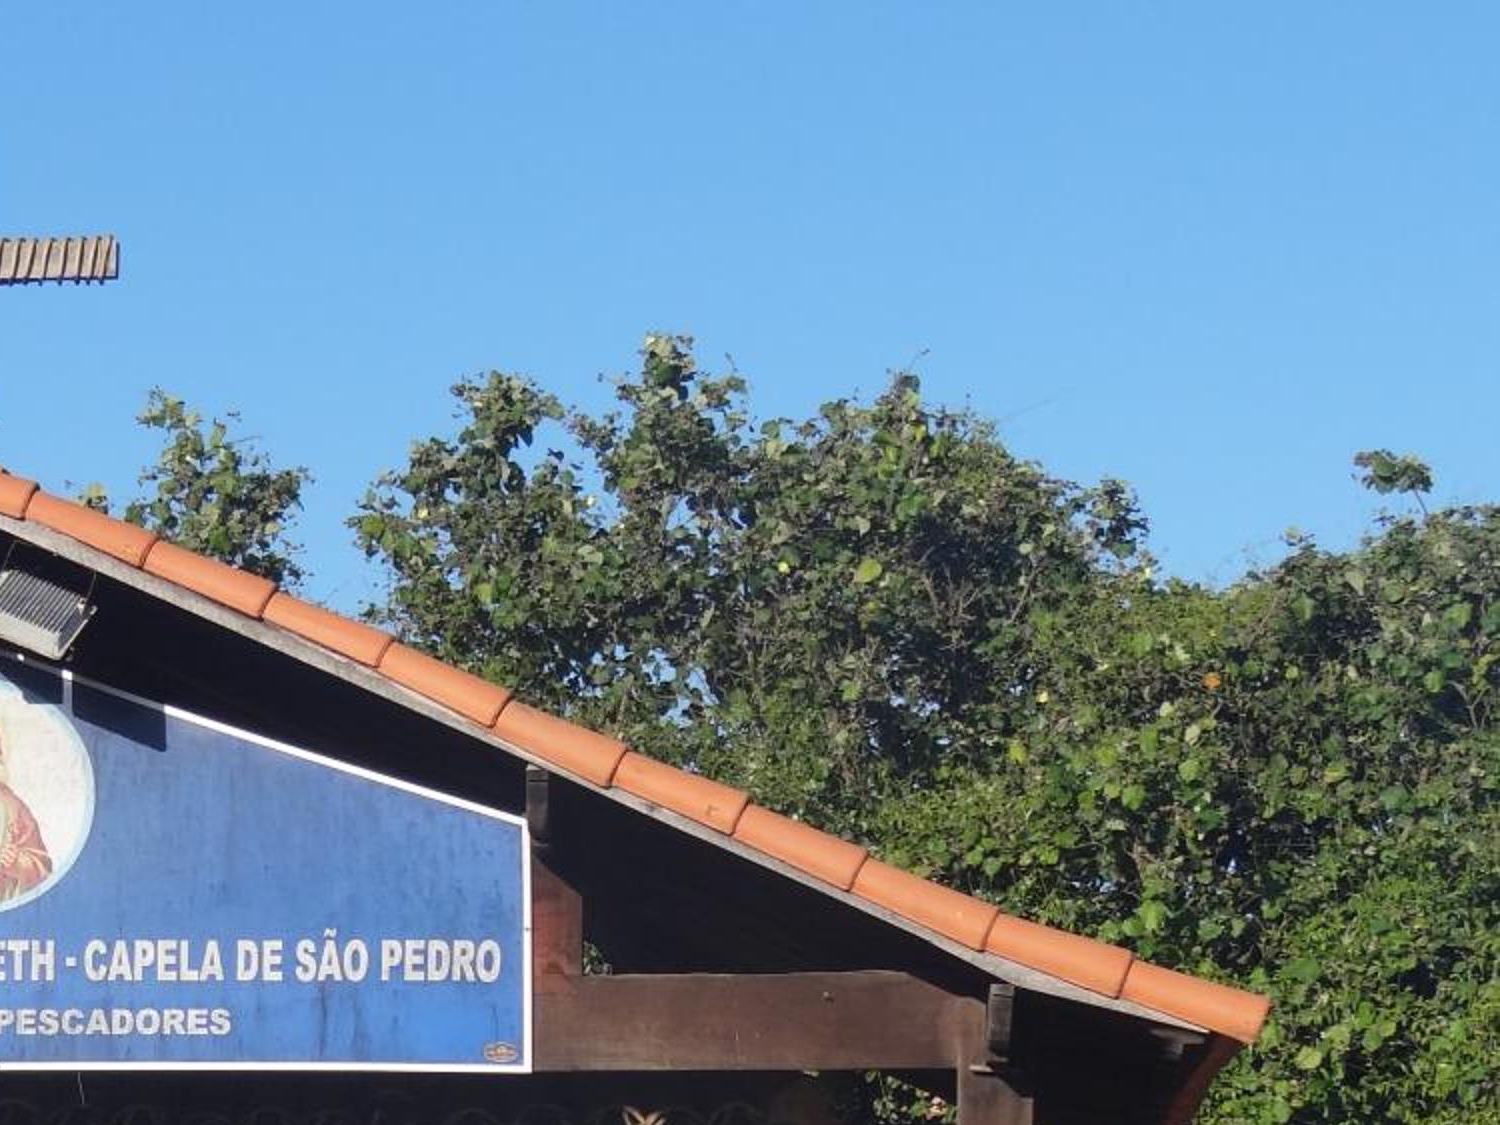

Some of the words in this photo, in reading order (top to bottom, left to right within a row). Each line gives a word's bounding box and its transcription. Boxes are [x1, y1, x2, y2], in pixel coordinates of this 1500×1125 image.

[83, 939, 225, 983] CAPELA
[236, 939, 283, 982] DE
[295, 928, 369, 983] SÃO
[381, 939, 501, 983] PEDRO
